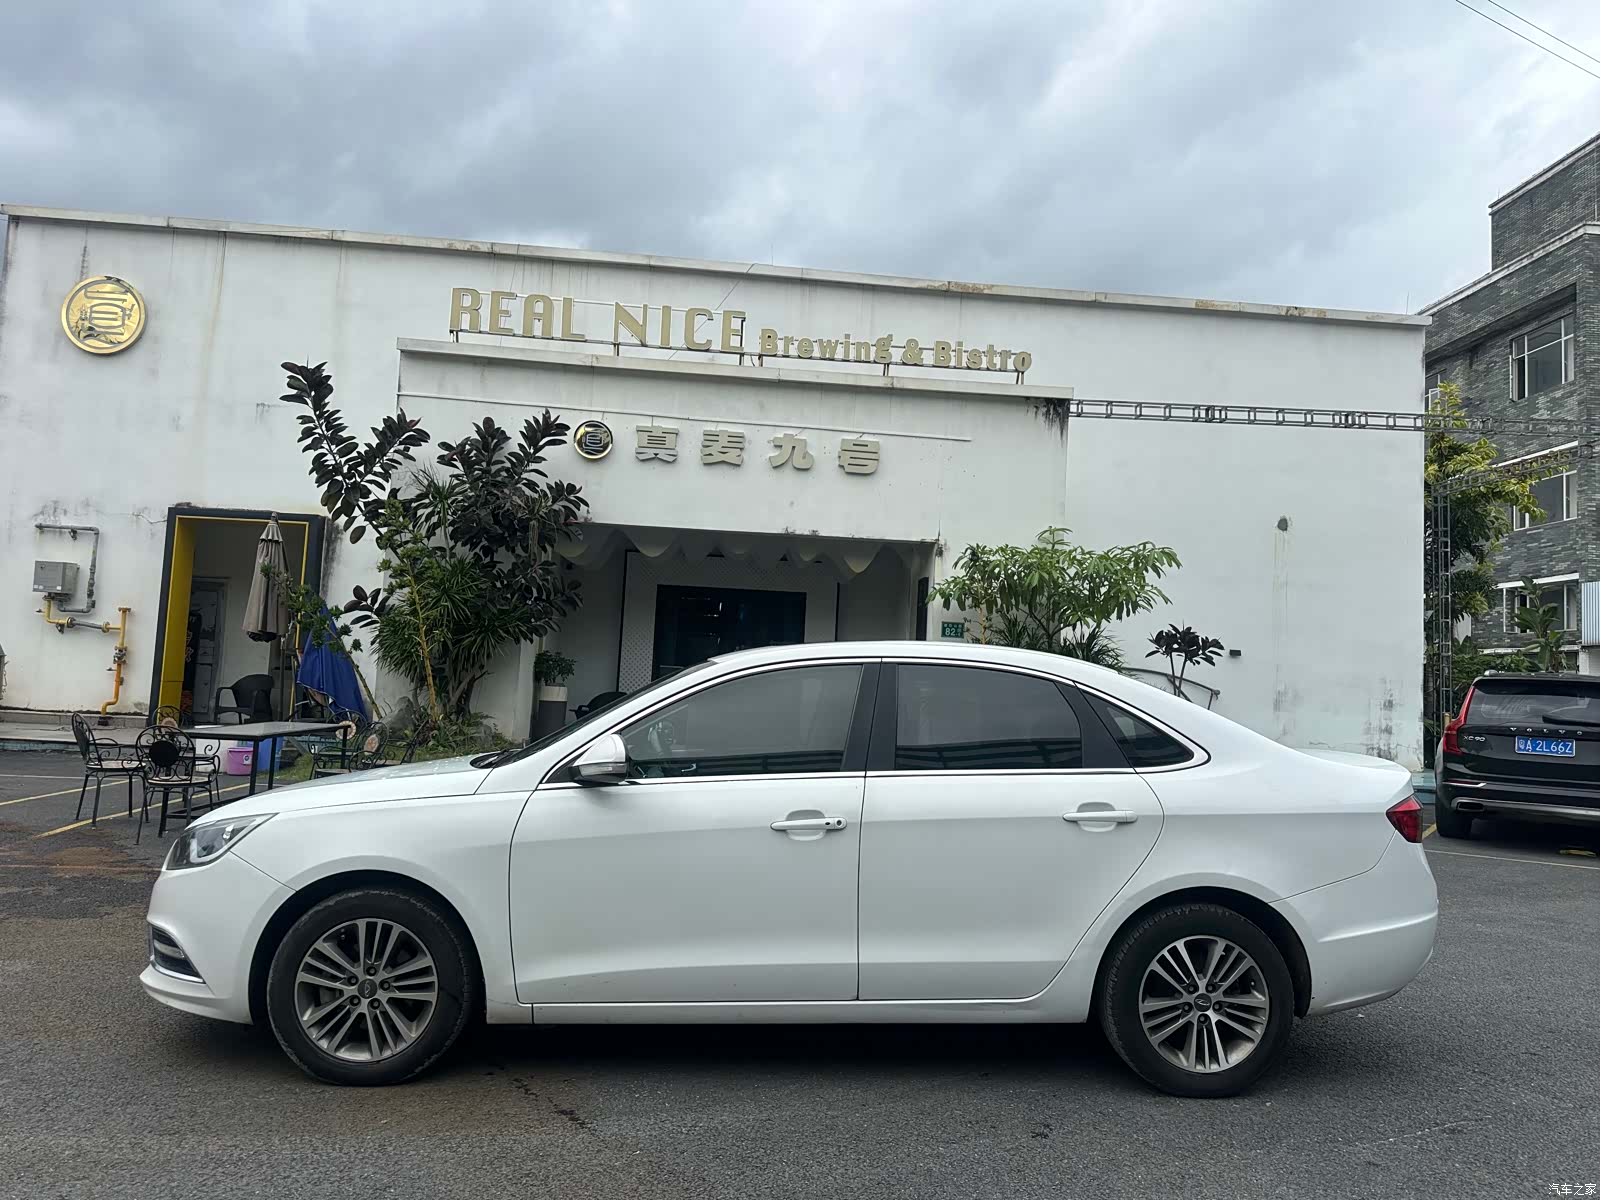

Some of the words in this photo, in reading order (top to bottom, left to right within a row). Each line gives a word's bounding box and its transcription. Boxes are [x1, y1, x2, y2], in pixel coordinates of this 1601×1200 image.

[449, 287, 586, 342] REAL
[613, 301, 747, 353] NICE
[759, 328, 893, 364] Brewing
[901, 338, 924, 365] &
[933, 340, 1032, 373] Bistro
[634, 425, 881, 475] 真麦九号
[1510, 727, 1582, 735] VOLVO
